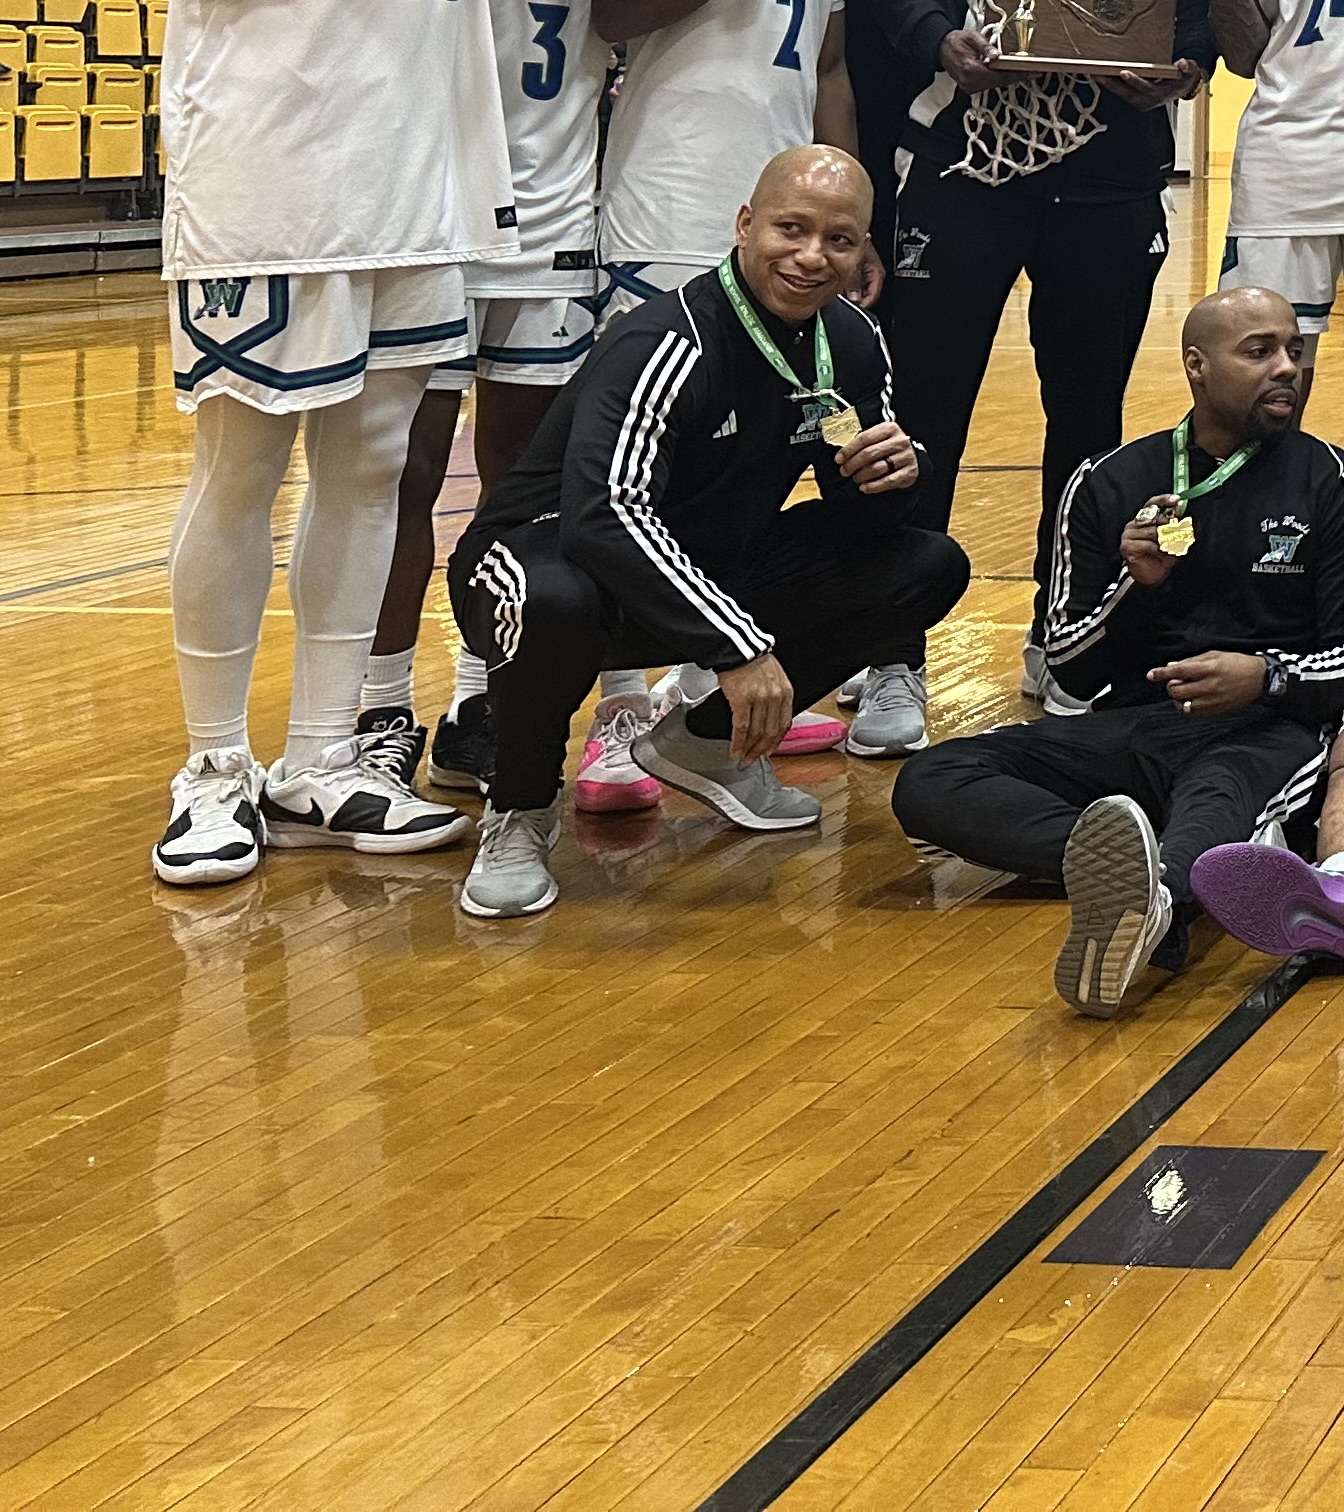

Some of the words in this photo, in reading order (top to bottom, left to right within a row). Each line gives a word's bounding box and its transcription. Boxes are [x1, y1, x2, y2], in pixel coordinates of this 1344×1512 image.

[521, 1, 569, 101] 3
[1260, 518, 1278, 532] The
[1252, 563, 1304, 573] BASKETBALL
